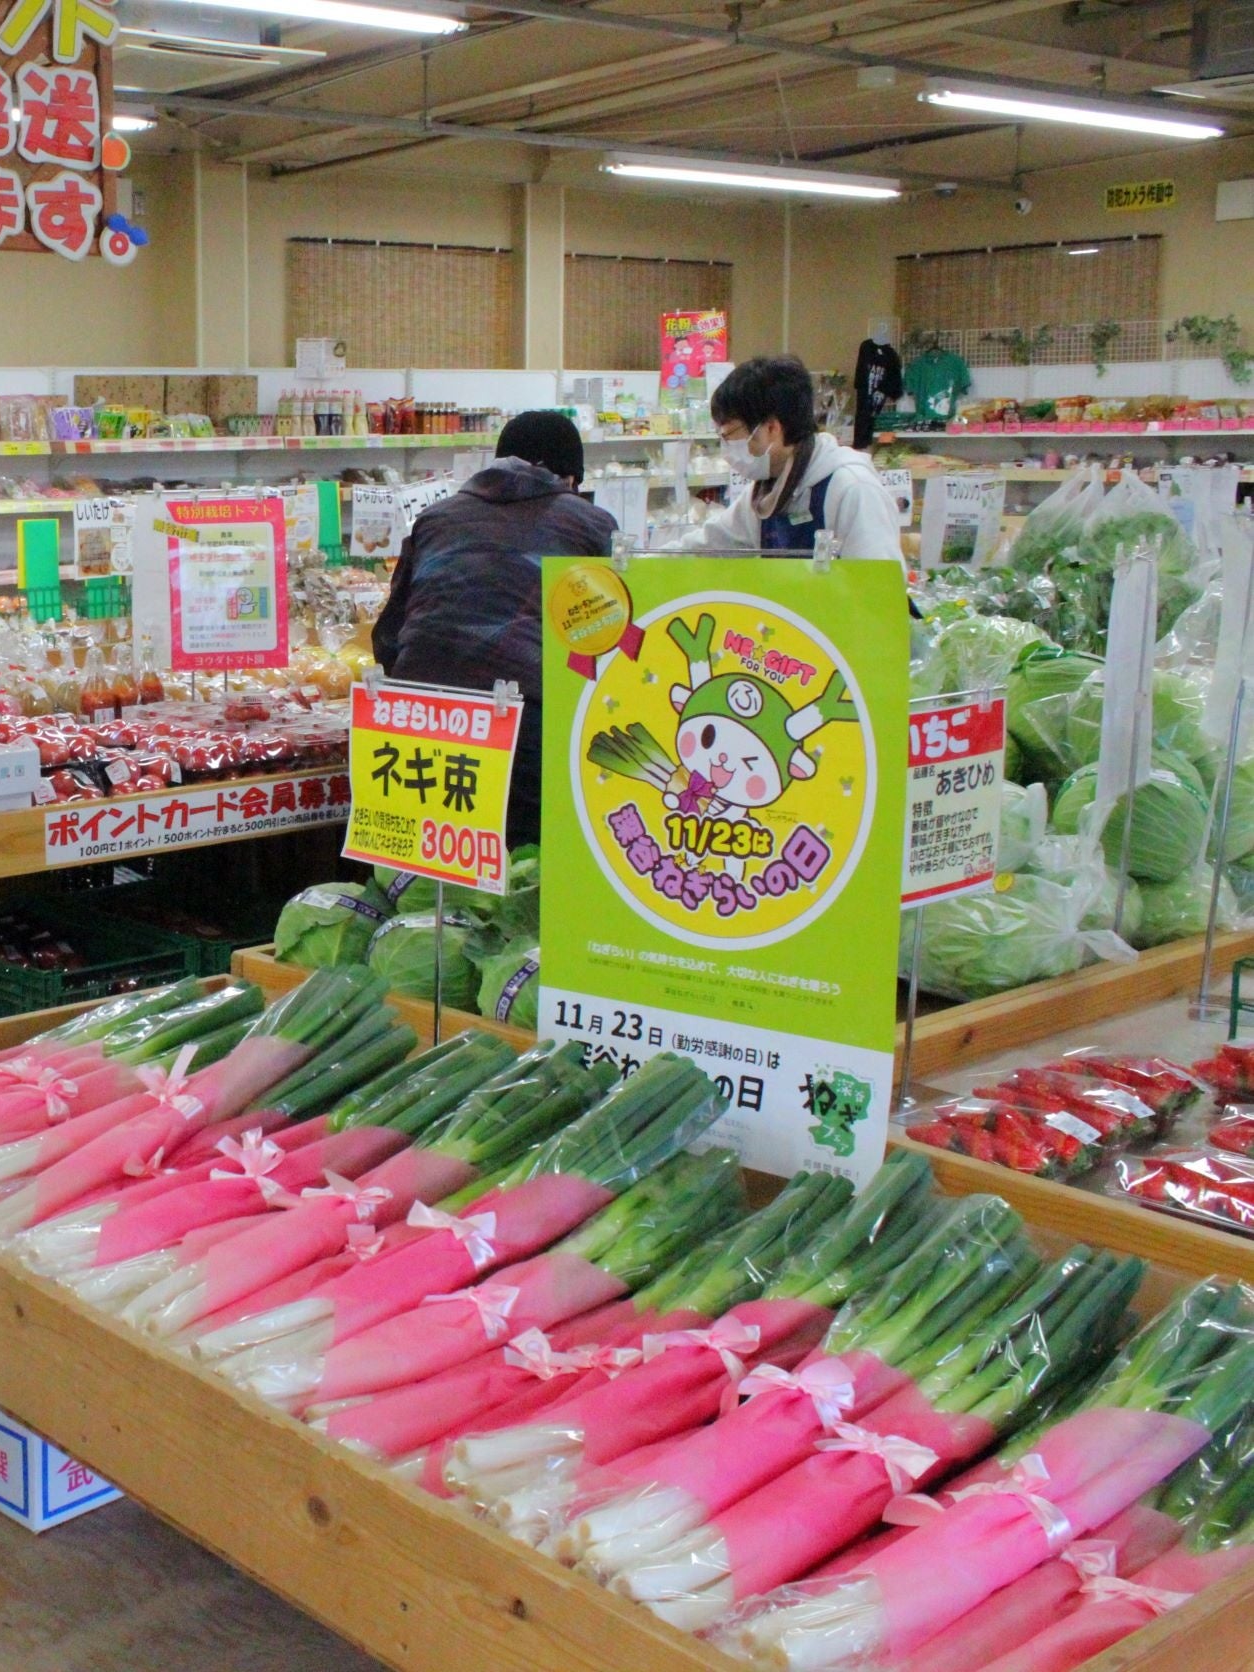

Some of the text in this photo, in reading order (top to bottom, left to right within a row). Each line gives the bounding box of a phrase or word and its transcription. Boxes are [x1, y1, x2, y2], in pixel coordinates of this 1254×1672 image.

[76, 503, 110, 520] しいたけ
[176, 504, 273, 519] 特別栽培トマト
[739, 657, 786, 685] FOR YOU
[373, 699, 491, 741] ねぎらいの日
[371, 741, 481, 813] ネギ束
[936, 760, 995, 796] あきひめ
[48, 774, 352, 846] ポイントカード会員募集
[421, 819, 502, 880] 300円
[665, 812, 774, 859] 11/23は
[608, 803, 831, 917] 深谷ねぎらいの日
